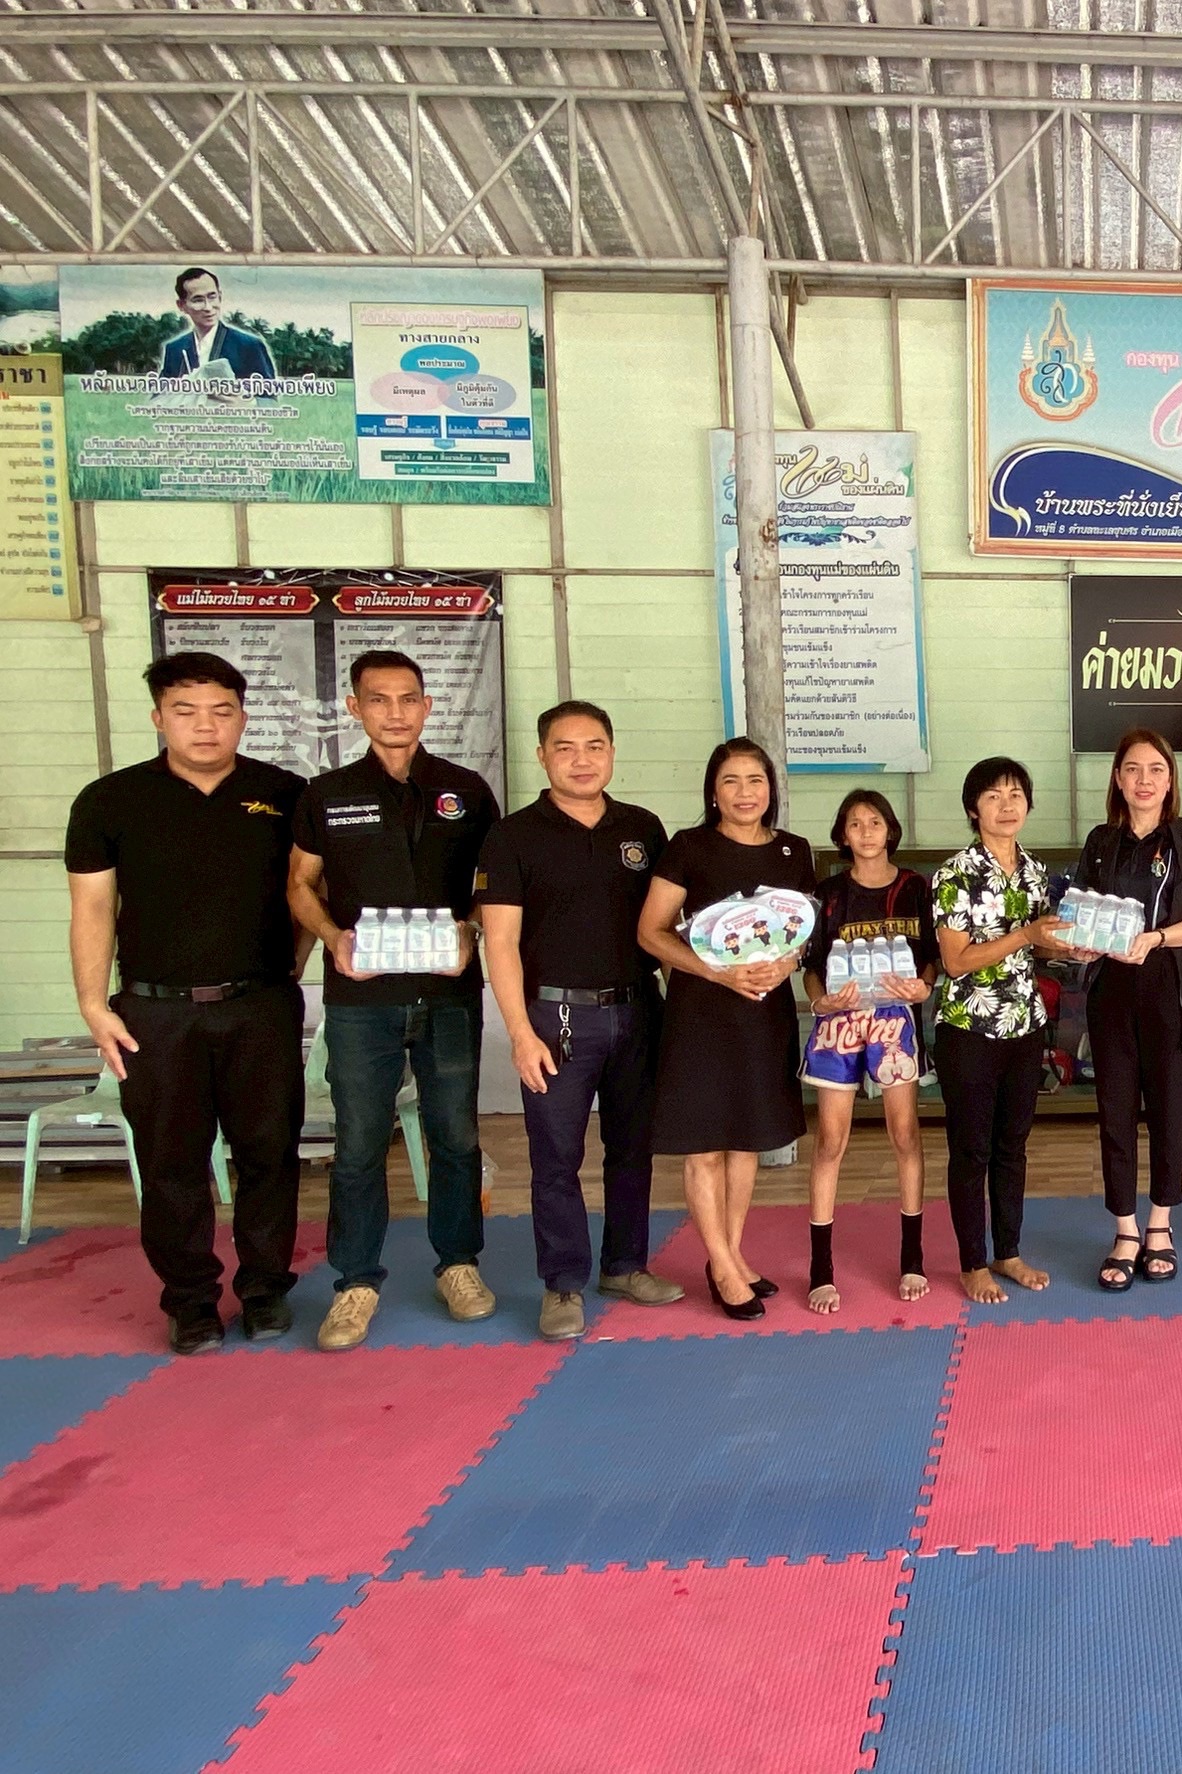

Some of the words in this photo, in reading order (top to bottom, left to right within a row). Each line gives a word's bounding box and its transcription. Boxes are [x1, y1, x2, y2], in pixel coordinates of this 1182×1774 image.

[399, 333, 480, 344] ทางสายกลาง
[419, 359, 465, 368] พอประมาณ
[1126, 352, 1179, 373] กองทุน
[81, 373, 335, 398] หลักแนวคิดของเศรษฐกิจพอเพียง
[841, 477, 904, 495] ของแผ่นดิน
[1035, 521, 1056, 538] หมู่ที่
[1059, 525, 1065, 533] 8
[1069, 523, 1137, 539] ตำบลทะเลชุบศร
[176, 589, 254, 606] แม่ไม้มวยไทย
[258, 595, 275, 606] ๑๕
[280, 592, 296, 606] ท่า
[354, 590, 430, 612] ลูกไม้มวยไทย
[434, 596, 452, 607] ๑๕
[455, 592, 471, 607] ท่า
[781, 588, 874, 604] ข้าใจโครงการทุกครัวเรือน
[783, 641, 833, 655] ชุมชนเข้มแข็ง
[783, 674, 875, 689] งทุนแก้ไขปัญหายาเสพติด
[864, 708, 915, 721] (อย่างต่อเนื่อง)
[841, 923, 880, 943] MUAY
[885, 919, 920, 937] THAI
